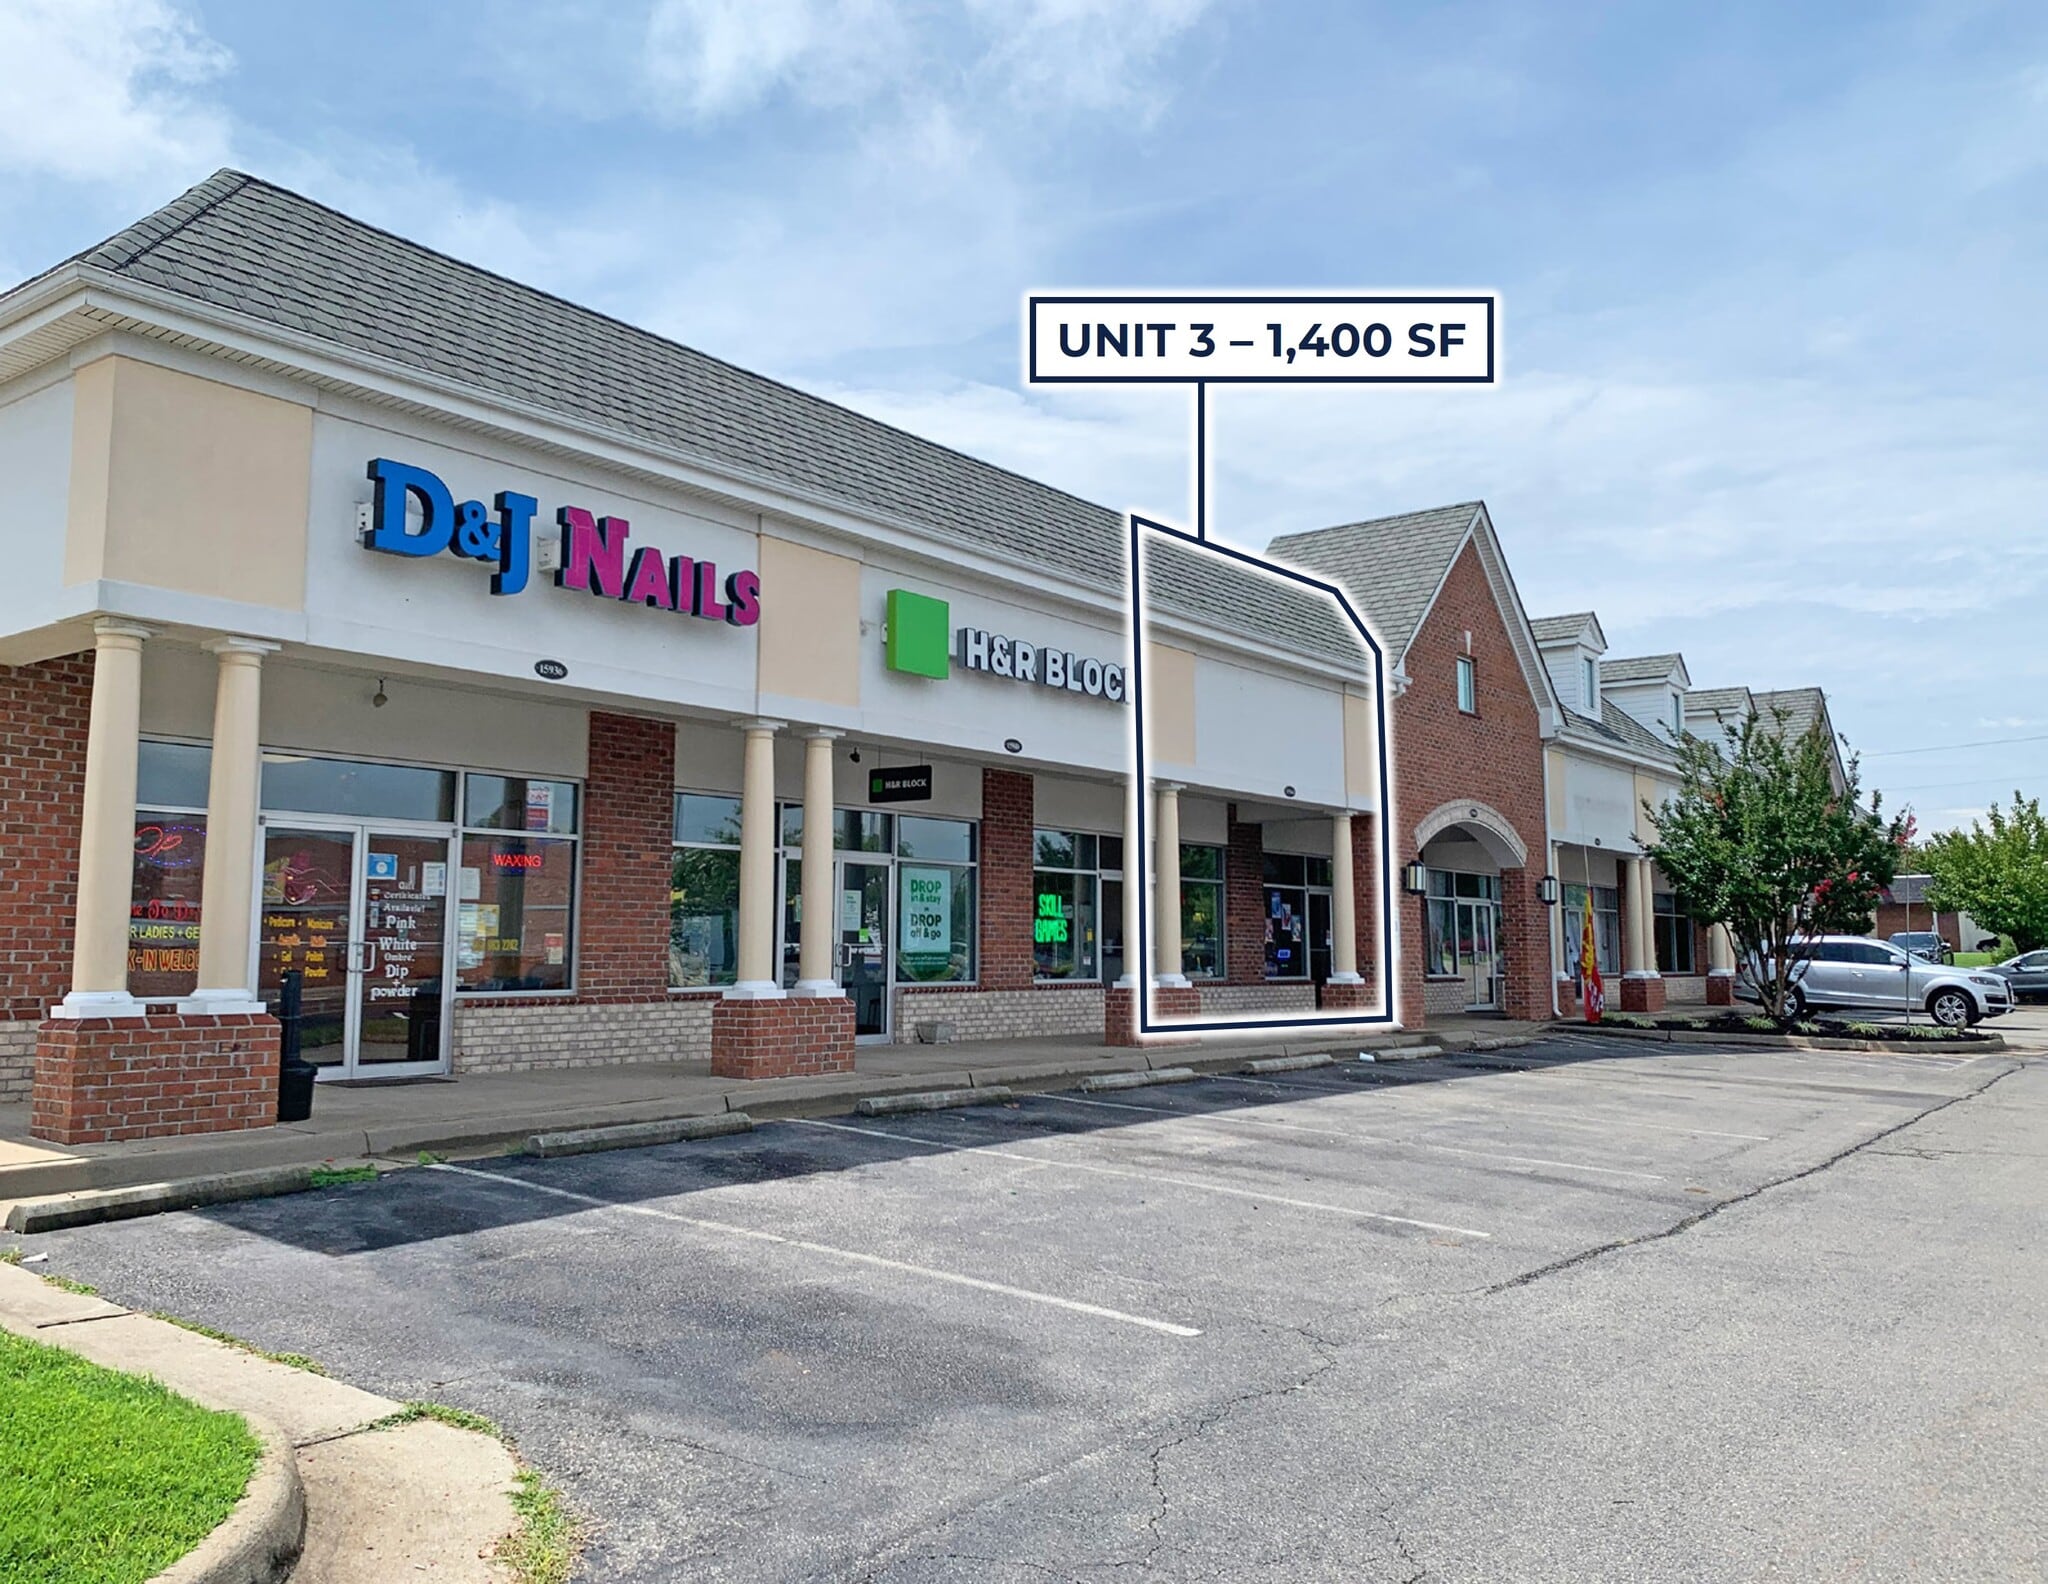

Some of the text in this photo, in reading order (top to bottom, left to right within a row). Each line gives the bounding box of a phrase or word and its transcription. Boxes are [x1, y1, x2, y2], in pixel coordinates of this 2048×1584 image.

[364, 458, 761, 627] D&J NAILS
[957, 627, 1036, 682] H&R
[902, 778, 927, 789] BLOCK
[493, 854, 542, 867] WAXING
[911, 880, 941, 893] DROP
[926, 895, 941, 904] stay
[1038, 894, 1064, 917] SKILL
[386, 915, 416, 929] Pink
[911, 914, 941, 927] DROP
[140, 926, 175, 938] LADIES
[924, 928, 929, 938] &
[931, 930, 941, 940] go
[1035, 919, 1067, 943] GAMES
[379, 937, 417, 950] White
[128, 949, 157, 971] K-IN
[305, 967, 328, 977] Powder
[385, 964, 409, 982] Dip
[370, 984, 418, 1000] powder
